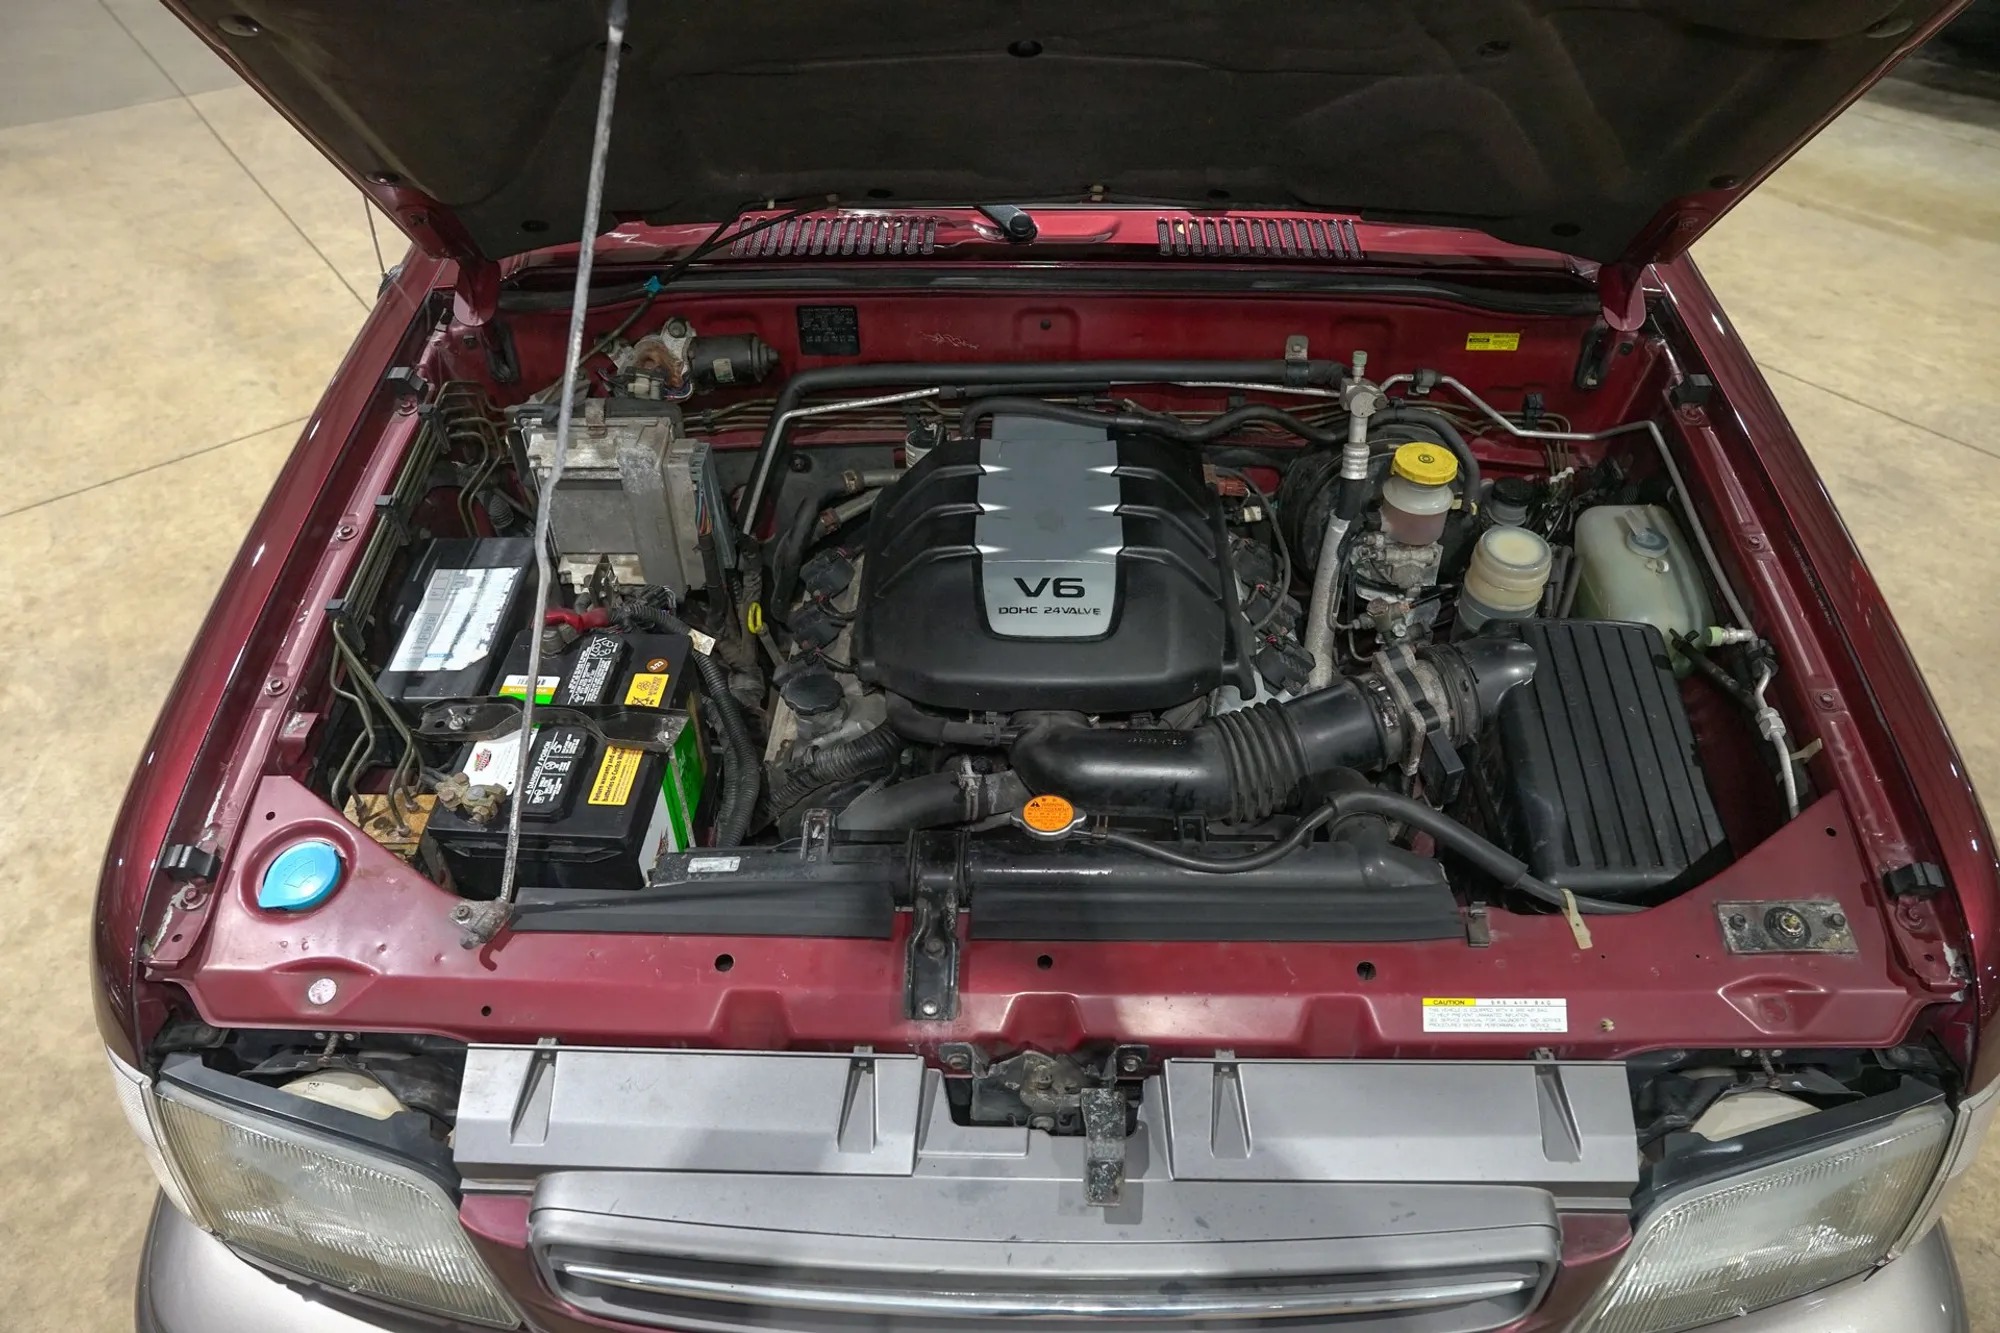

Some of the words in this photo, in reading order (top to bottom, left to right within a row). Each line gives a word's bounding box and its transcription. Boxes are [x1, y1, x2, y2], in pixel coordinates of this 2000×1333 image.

[1013, 577, 1085, 598] V6
[998, 606, 1038, 615] DOHC
[526, 765, 541, 789] DANGER
[538, 740, 552, 761] POISON
